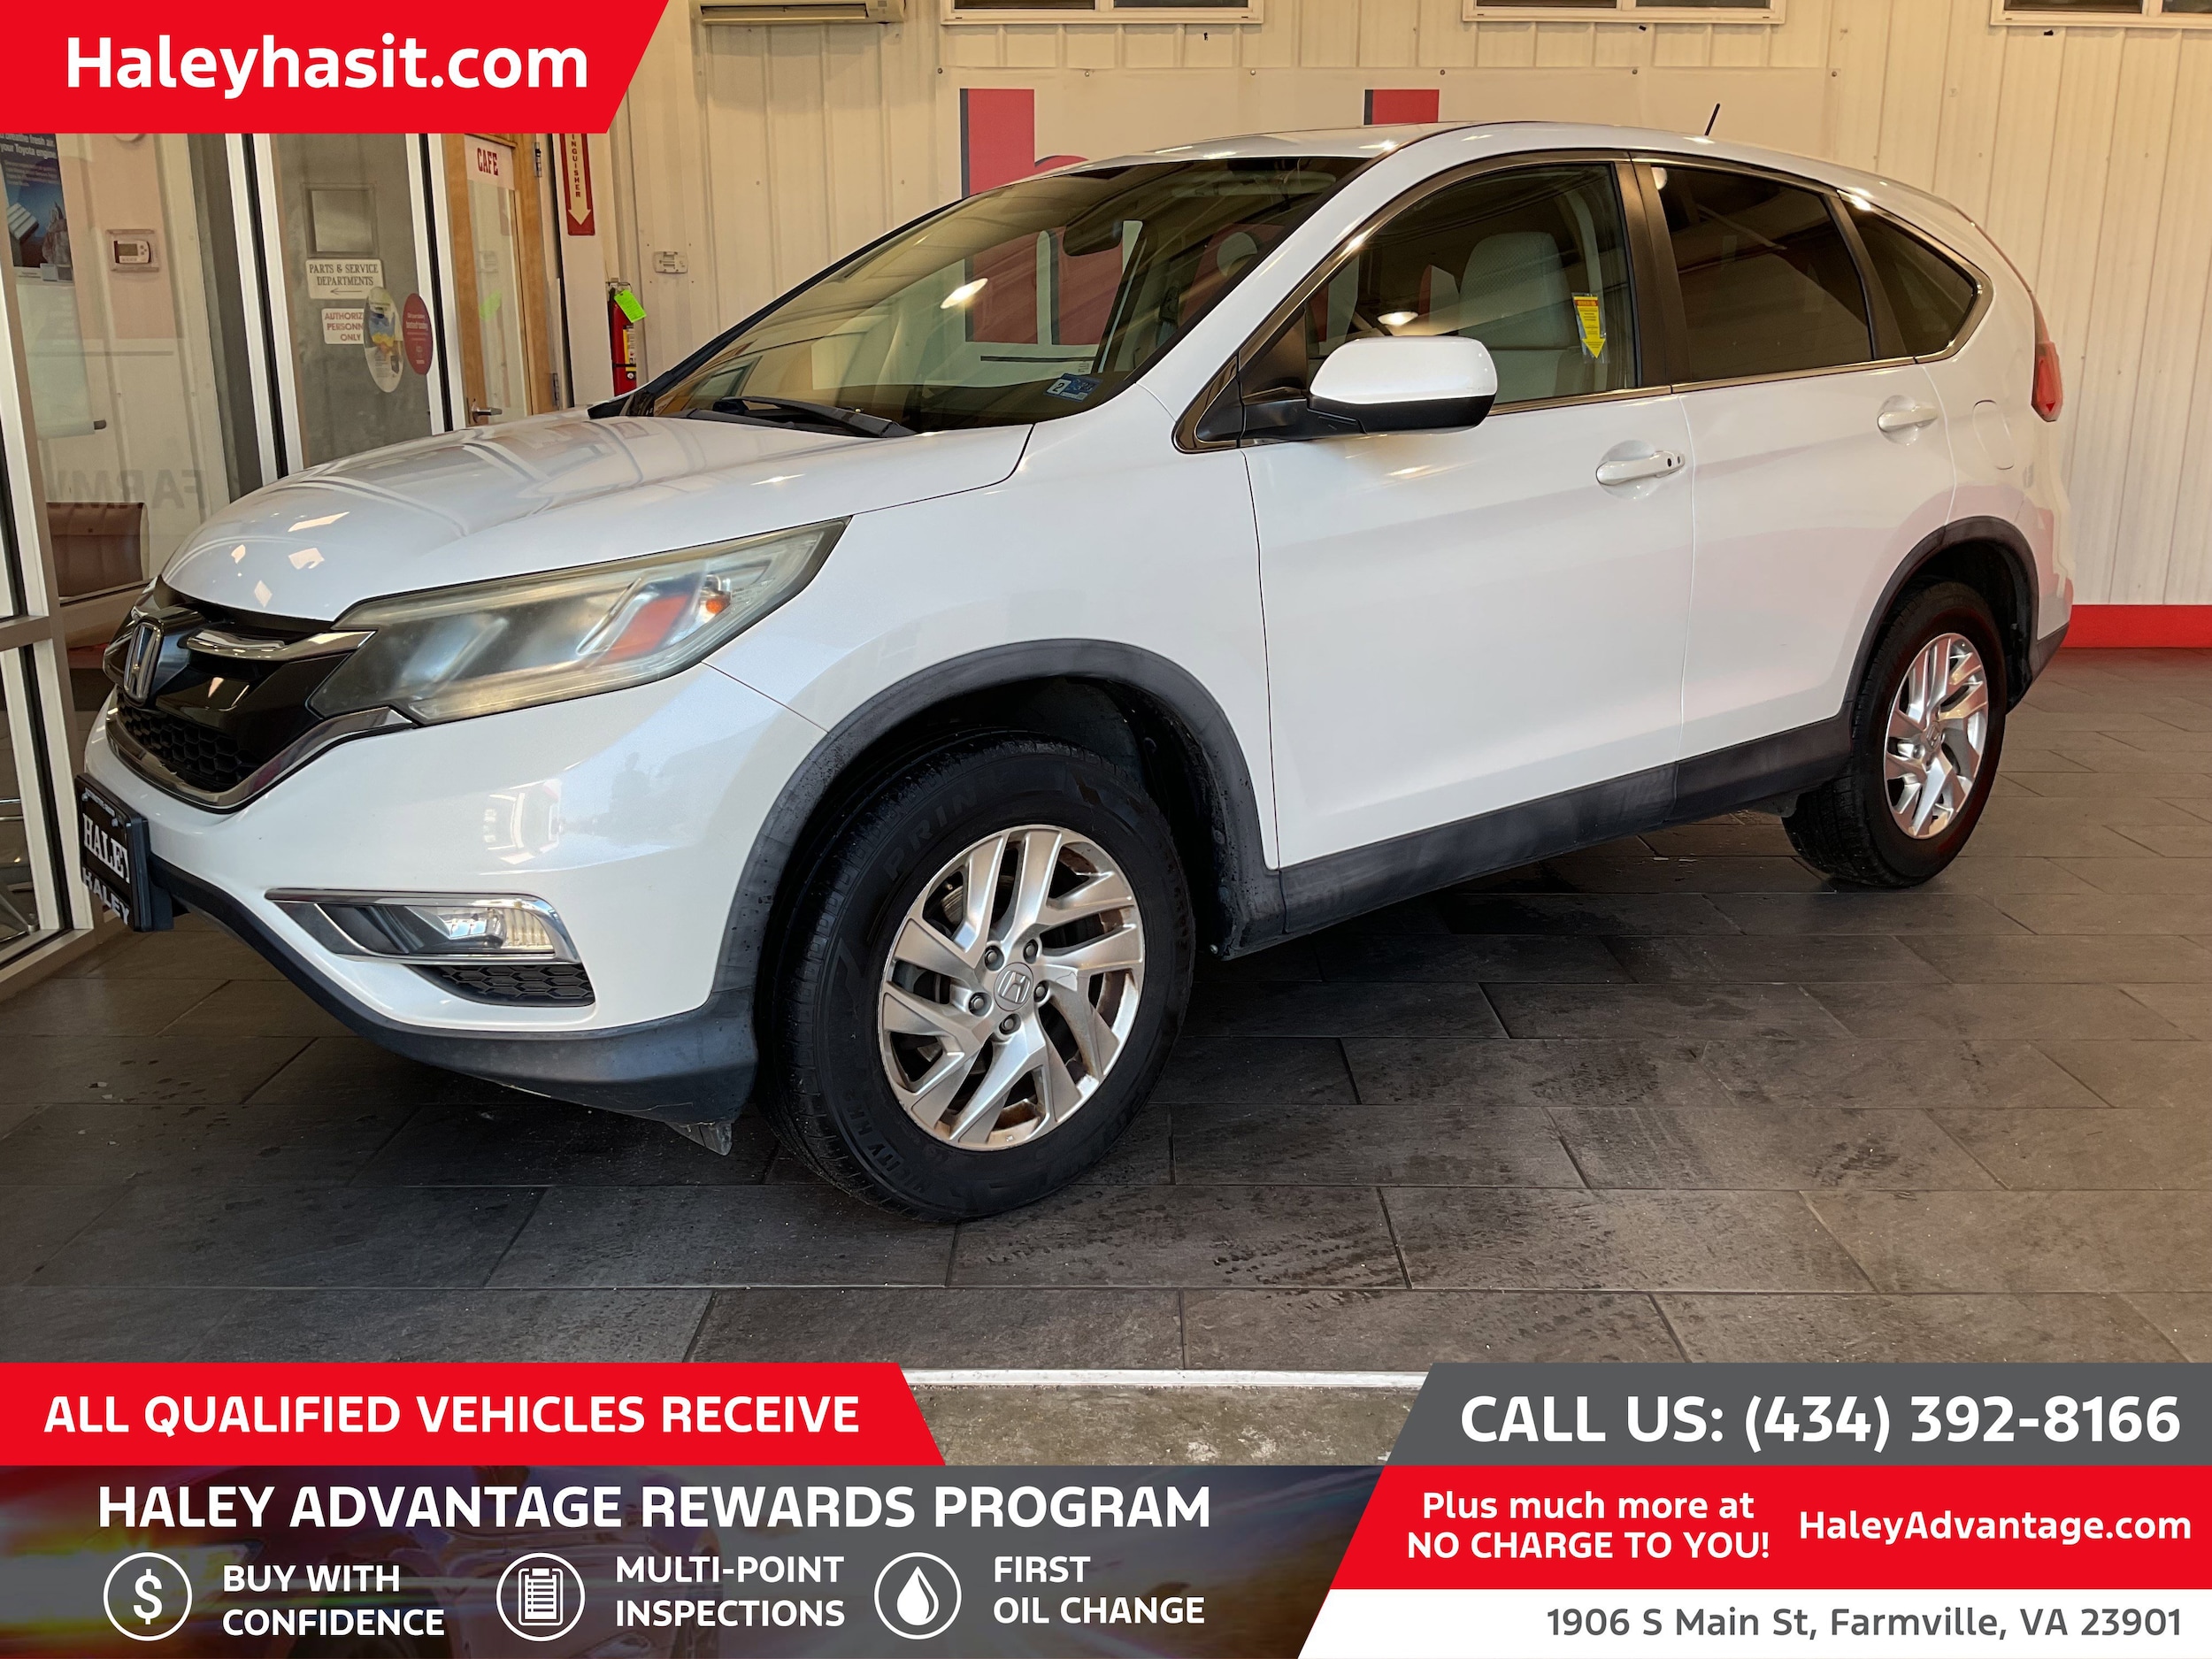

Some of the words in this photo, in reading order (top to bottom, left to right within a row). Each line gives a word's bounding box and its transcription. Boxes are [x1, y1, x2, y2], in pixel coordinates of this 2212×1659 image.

[14, 142, 35, 156] Toyota
[477, 147, 499, 176] CAFE
[309, 264, 334, 273] PARTS
[336, 264, 342, 273] &
[345, 264, 379, 273] SERVICE
[317, 276, 373, 286] DEPARTMENTS
[81, 813, 131, 884] HALEY
[81, 866, 130, 926] HALEY
